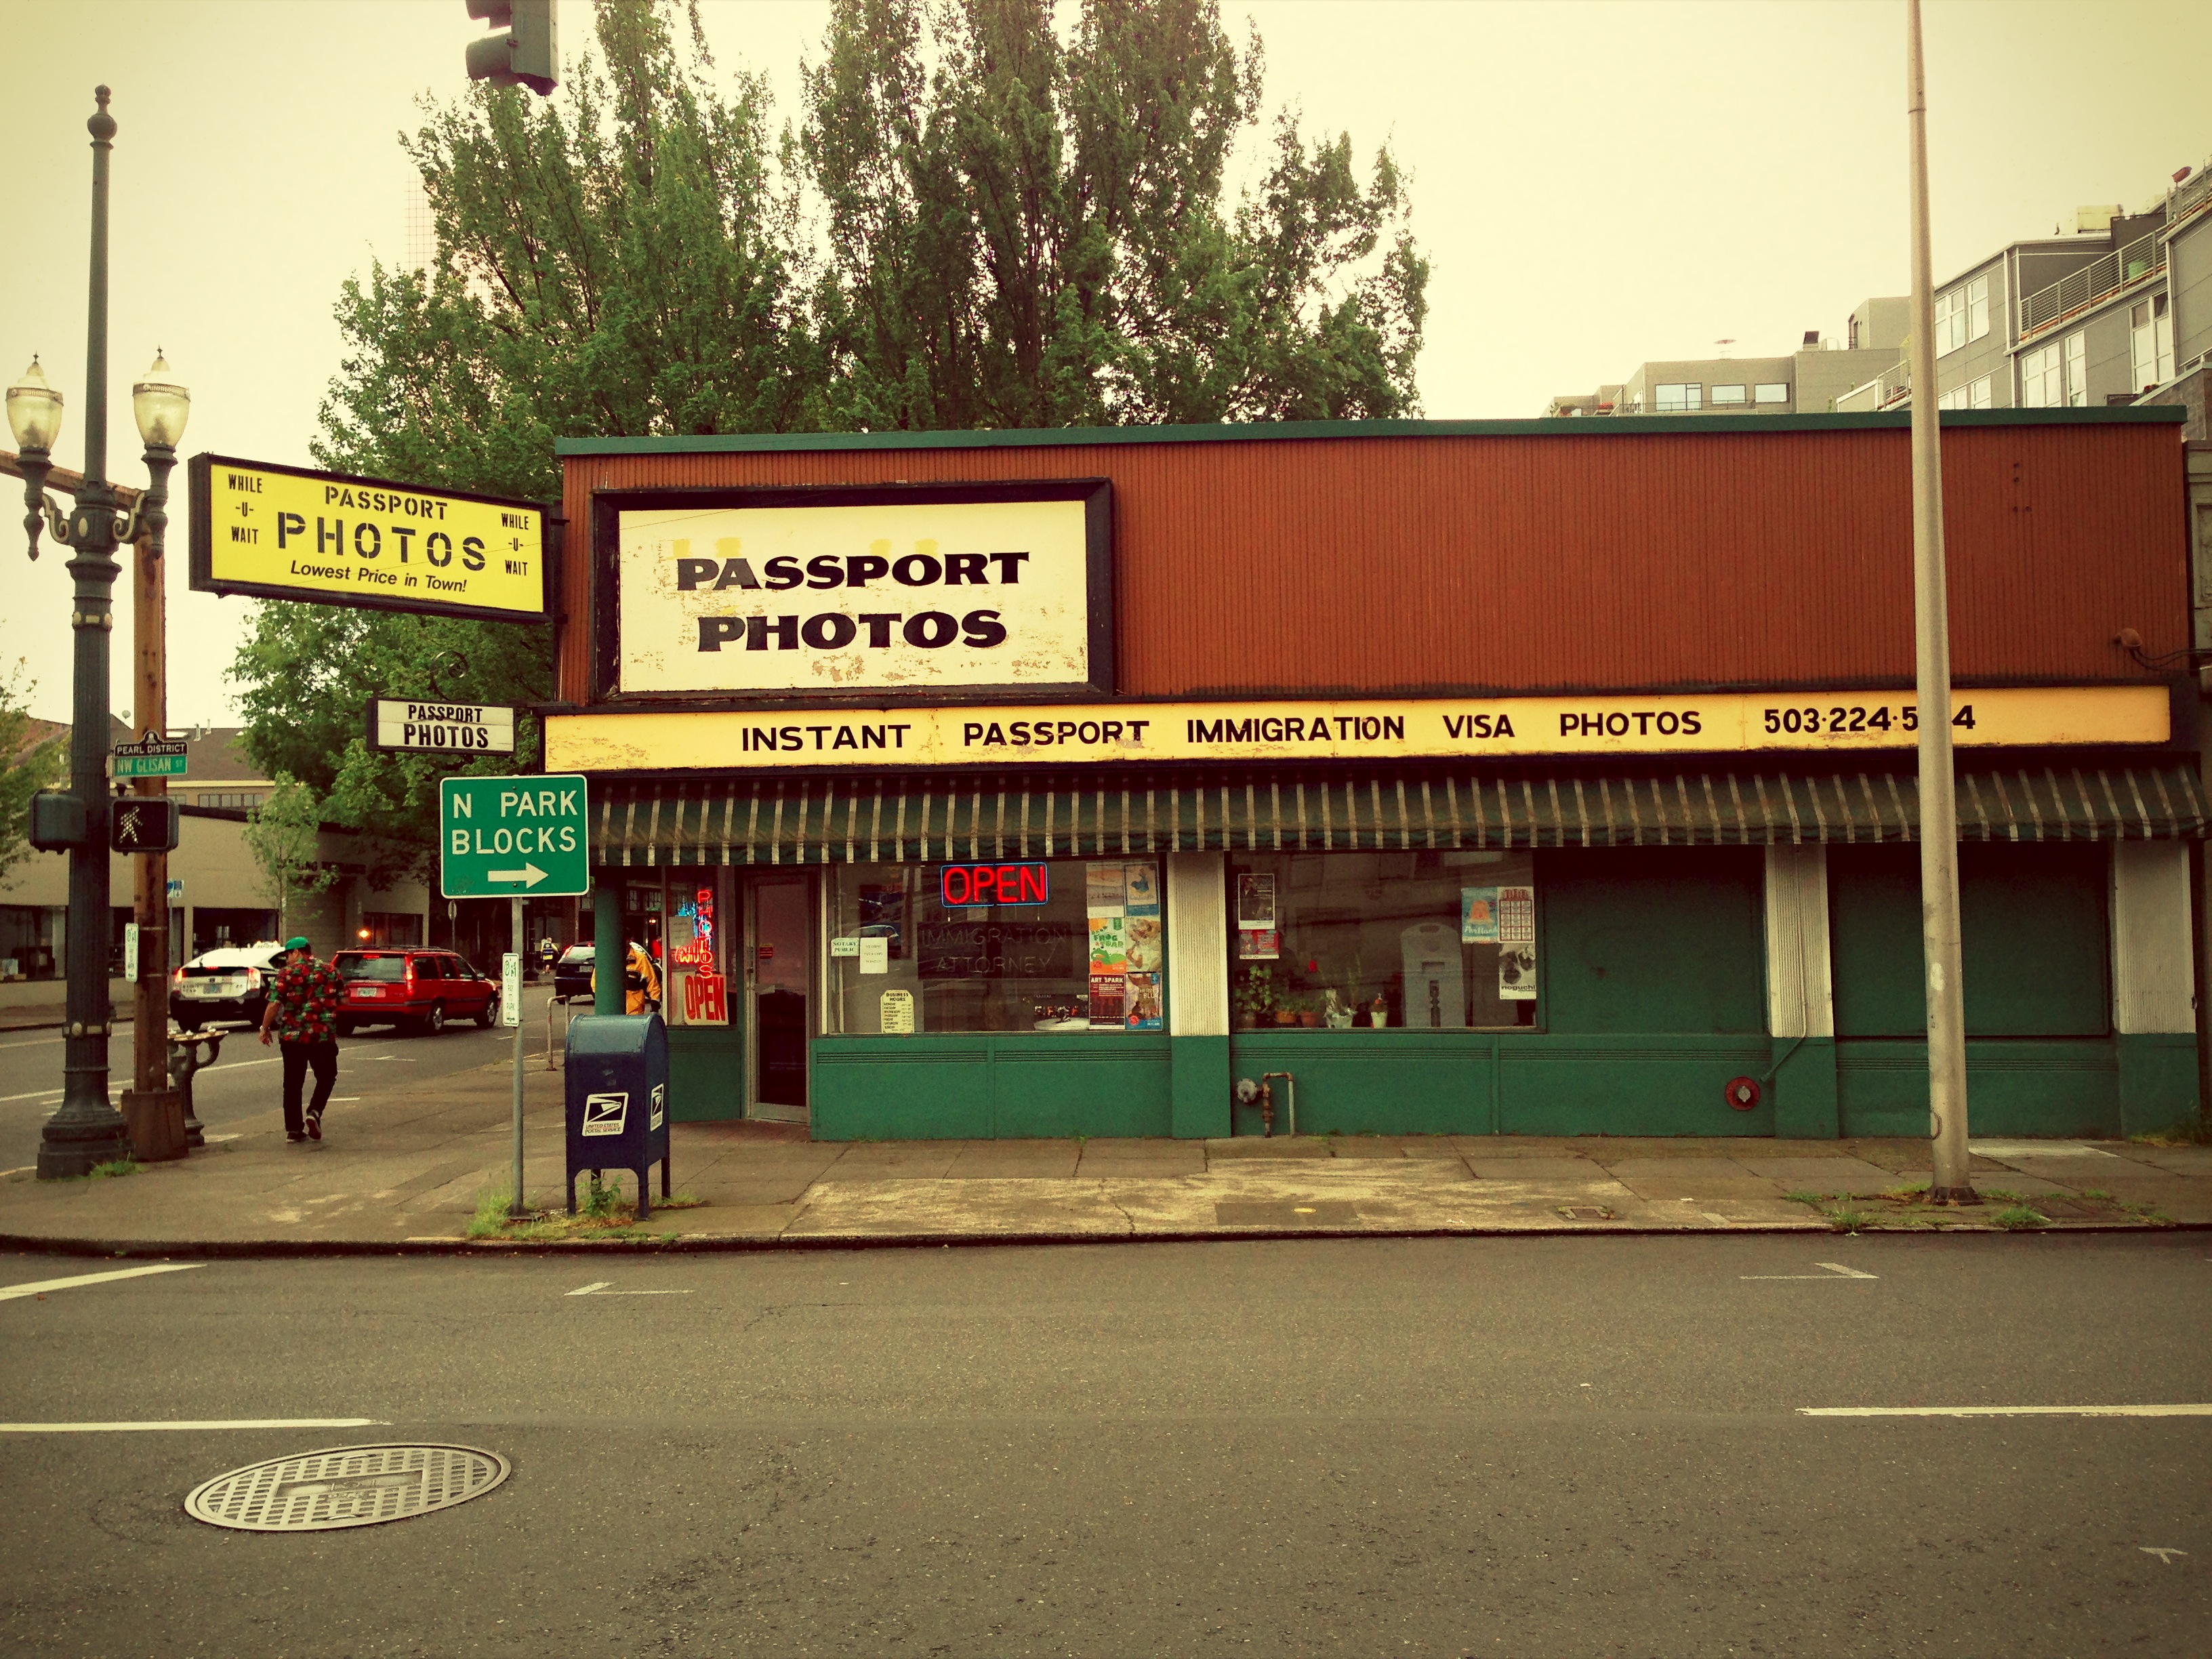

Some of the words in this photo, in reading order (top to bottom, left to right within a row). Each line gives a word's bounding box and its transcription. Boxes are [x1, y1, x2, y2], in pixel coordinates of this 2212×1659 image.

[228, 474, 263, 493] WHILE
[325, 486, 448, 520] PASSPORT
[232, 526, 259, 545] WAIT
[501, 512, 529, 531] WHILE
[278, 512, 486, 571] PHOTOS
[291, 560, 351, 580] Lowest
[358, 567, 397, 586] Price
[405, 573, 417, 587] in
[426, 575, 468, 593] Town!
[505, 560, 528, 576] WAIT
[677, 551, 1030, 592] PASSPORT
[698, 609, 1007, 652] PHOTOS
[408, 704, 483, 722] PASSPORT
[404, 723, 489, 749] PHOTOS
[742, 724, 912, 752] INSTANT
[964, 720, 1150, 747] PASSPORT
[1187, 715, 1405, 743] IMMIGRATION
[1443, 714, 1516, 739] VISA
[1560, 711, 1702, 738] PHOTOS
[117, 745, 144, 754] PEARL
[147, 743, 185, 754] DISTRICT
[117, 759, 133, 773] NW
[136, 758, 171, 773] GLISAN
[453, 793, 472, 819] N
[501, 790, 578, 817] PARK
[452, 826, 576, 855] BLOCKS
[944, 865, 1045, 904] OPEN
[697, 890, 713, 979] PHOTOS
[922, 927, 1067, 945] IMMIGRATION
[937, 956, 1051, 972] ATTORNEY
[684, 975, 726, 1021] OPEN
